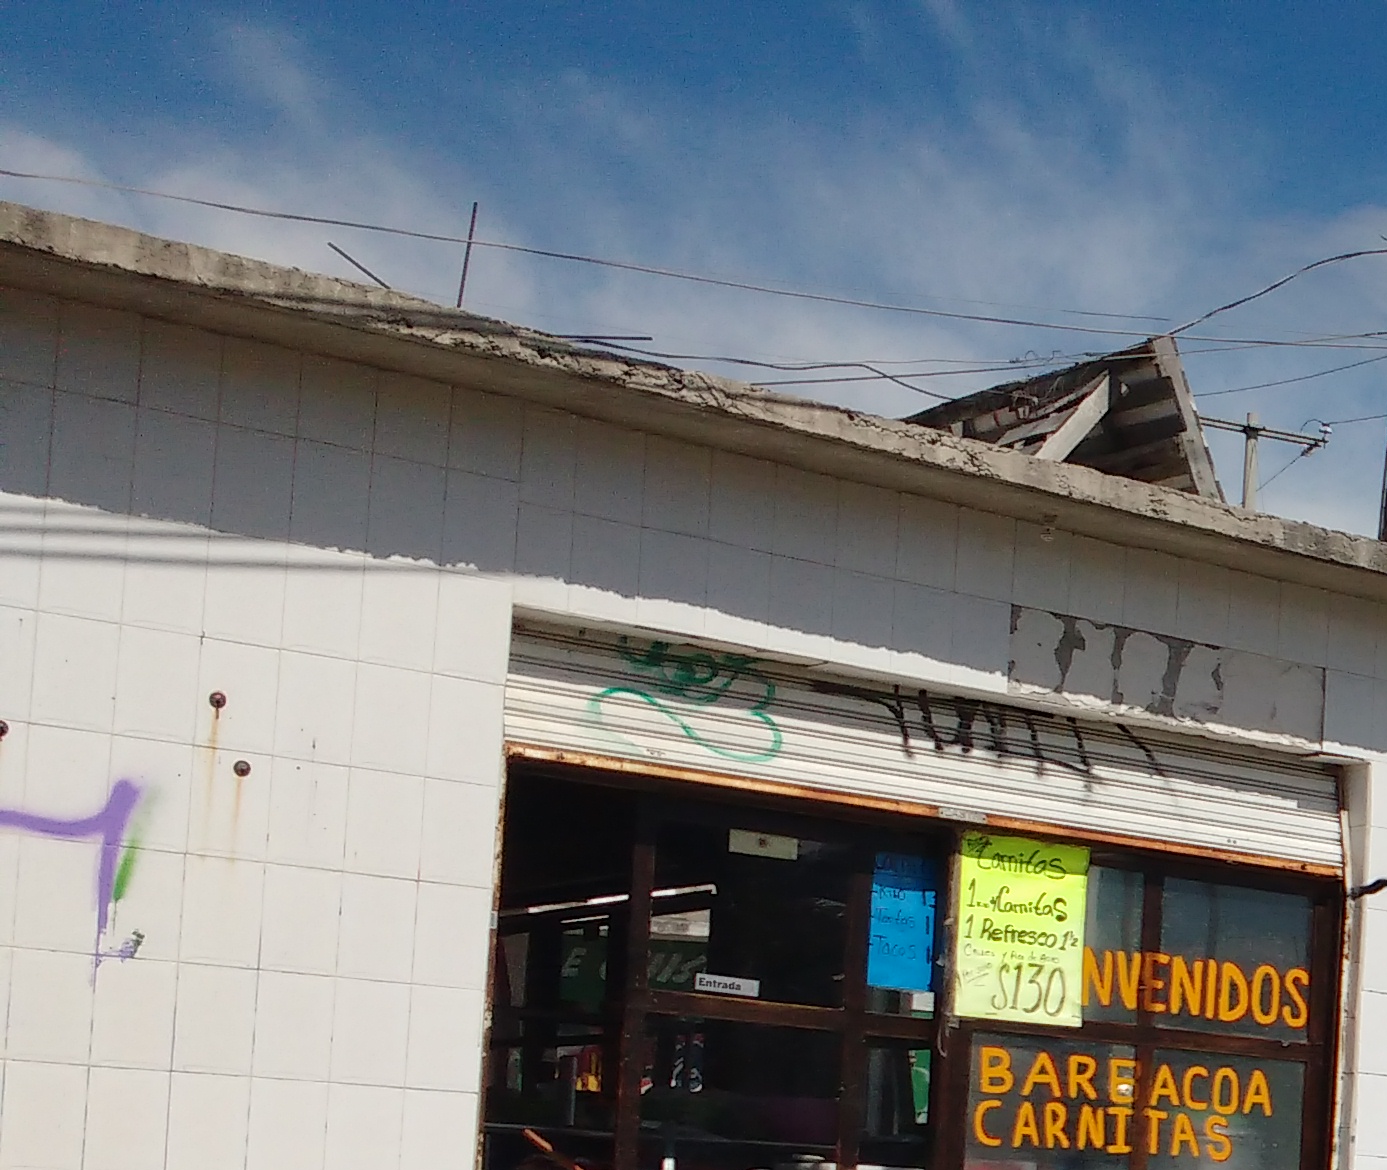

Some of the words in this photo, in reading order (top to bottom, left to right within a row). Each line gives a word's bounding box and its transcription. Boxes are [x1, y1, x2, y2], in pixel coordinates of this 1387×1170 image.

[977, 850, 1067, 879] Carnitas
[966, 878, 976, 907] 1
[996, 885, 1068, 922] Carnitas
[964, 914, 975, 938] 1
[980, 917, 1058, 949] Refresco
[698, 976, 742, 991] Entrada
[1081, 945, 1311, 1029] NVENIDOS
[972, 1099, 1233, 1163] CARNITAS
